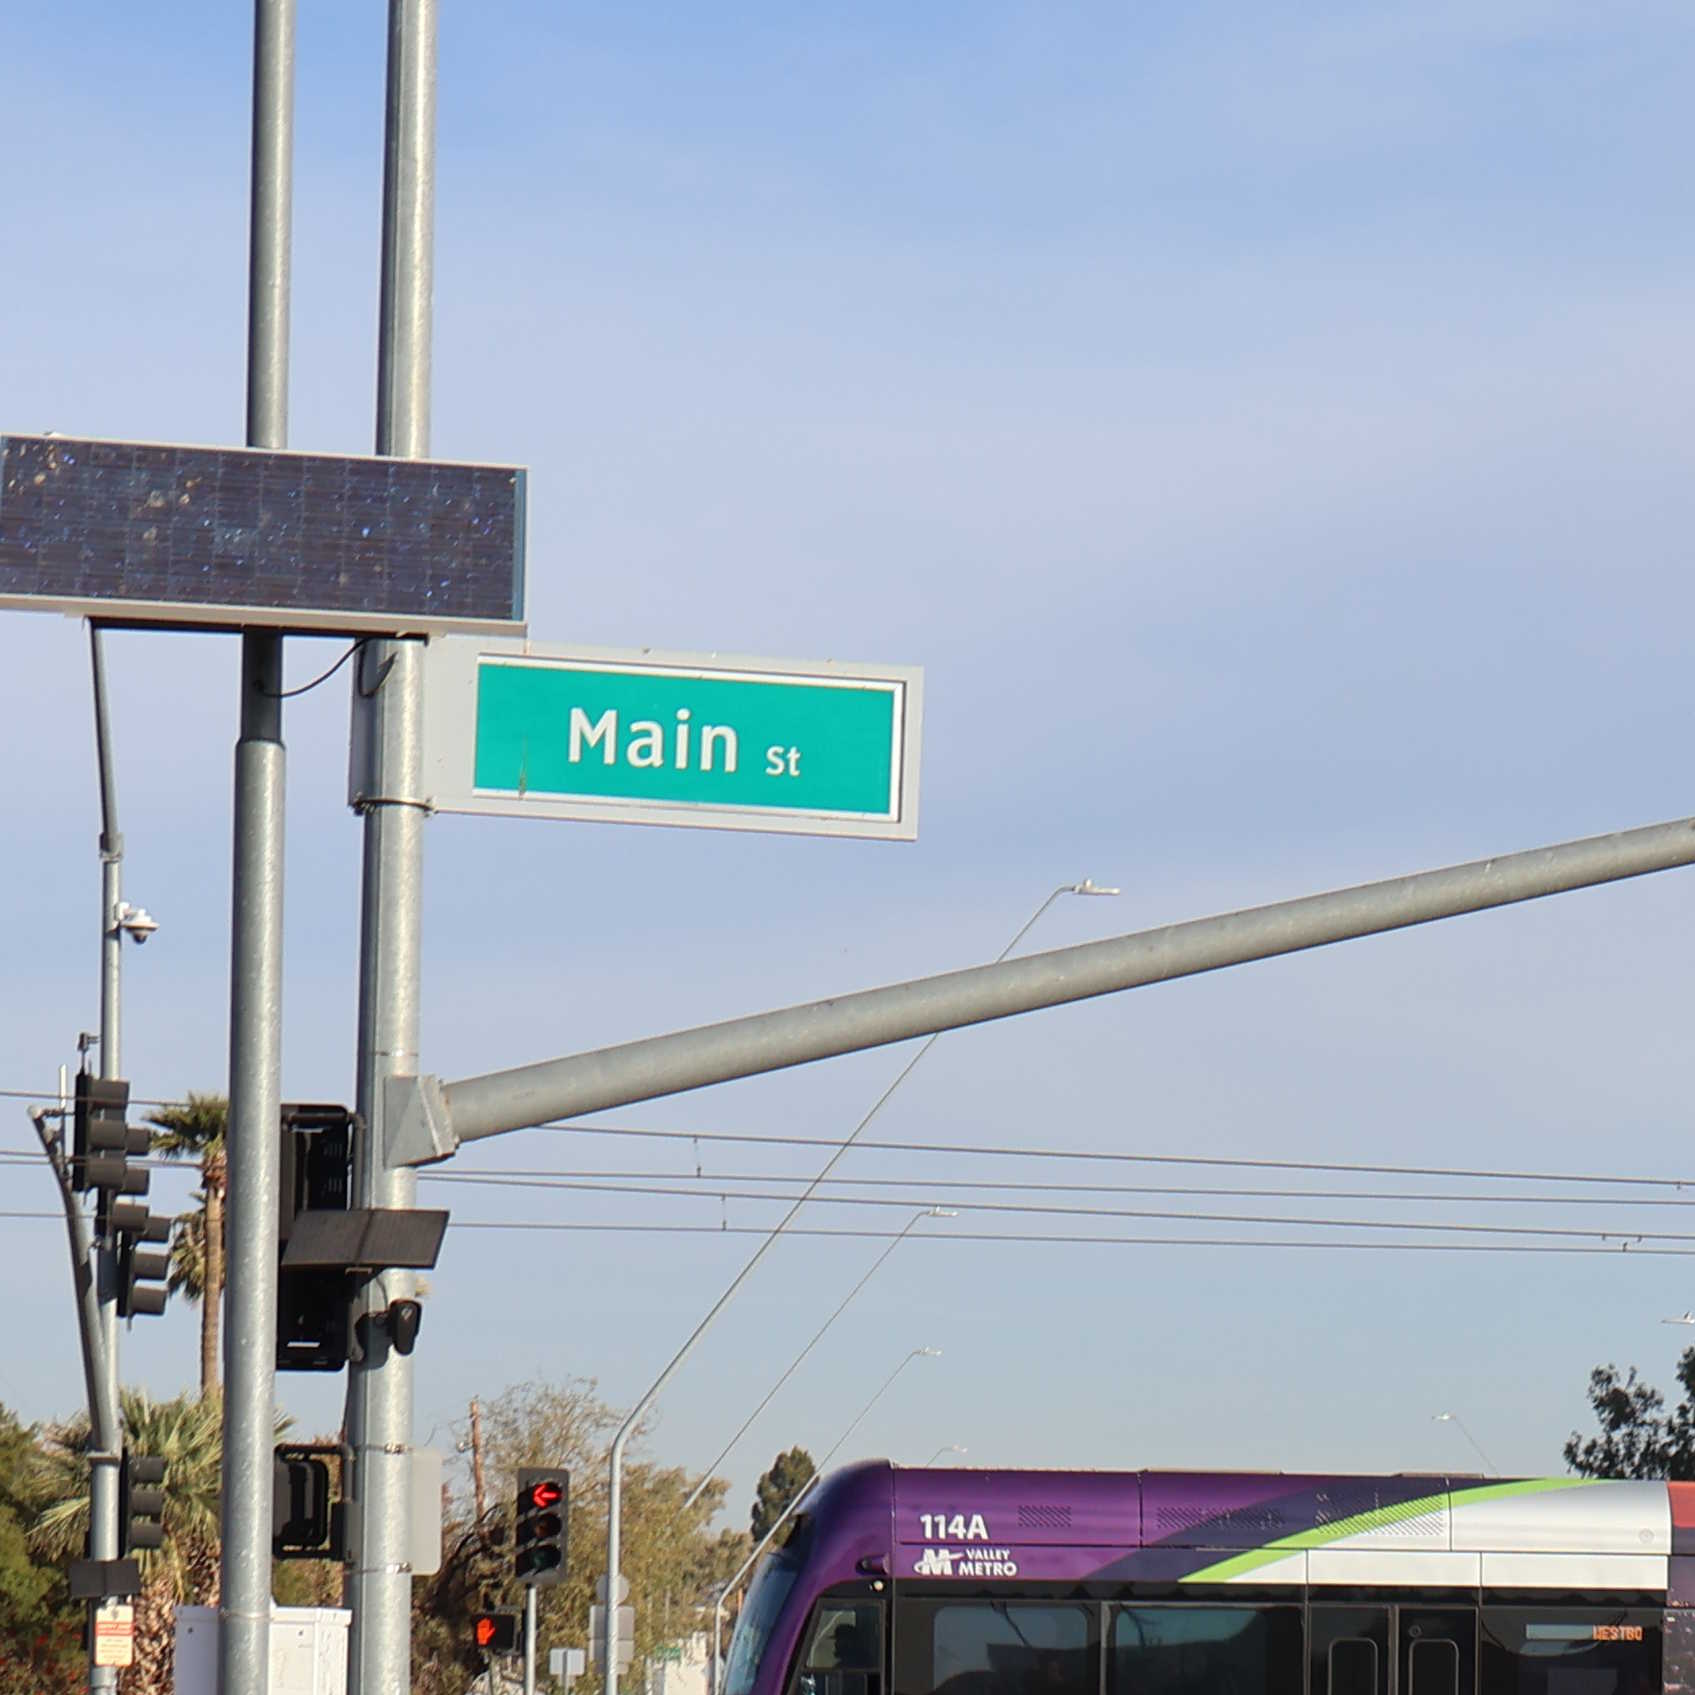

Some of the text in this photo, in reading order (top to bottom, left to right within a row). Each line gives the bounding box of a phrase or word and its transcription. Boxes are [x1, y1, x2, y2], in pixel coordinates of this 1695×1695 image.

[567, 706, 801, 778] Main St
[920, 1513, 989, 1540] 114A
[965, 1548, 1011, 1560] VALLEY
[958, 1560, 1018, 1577] METRO
